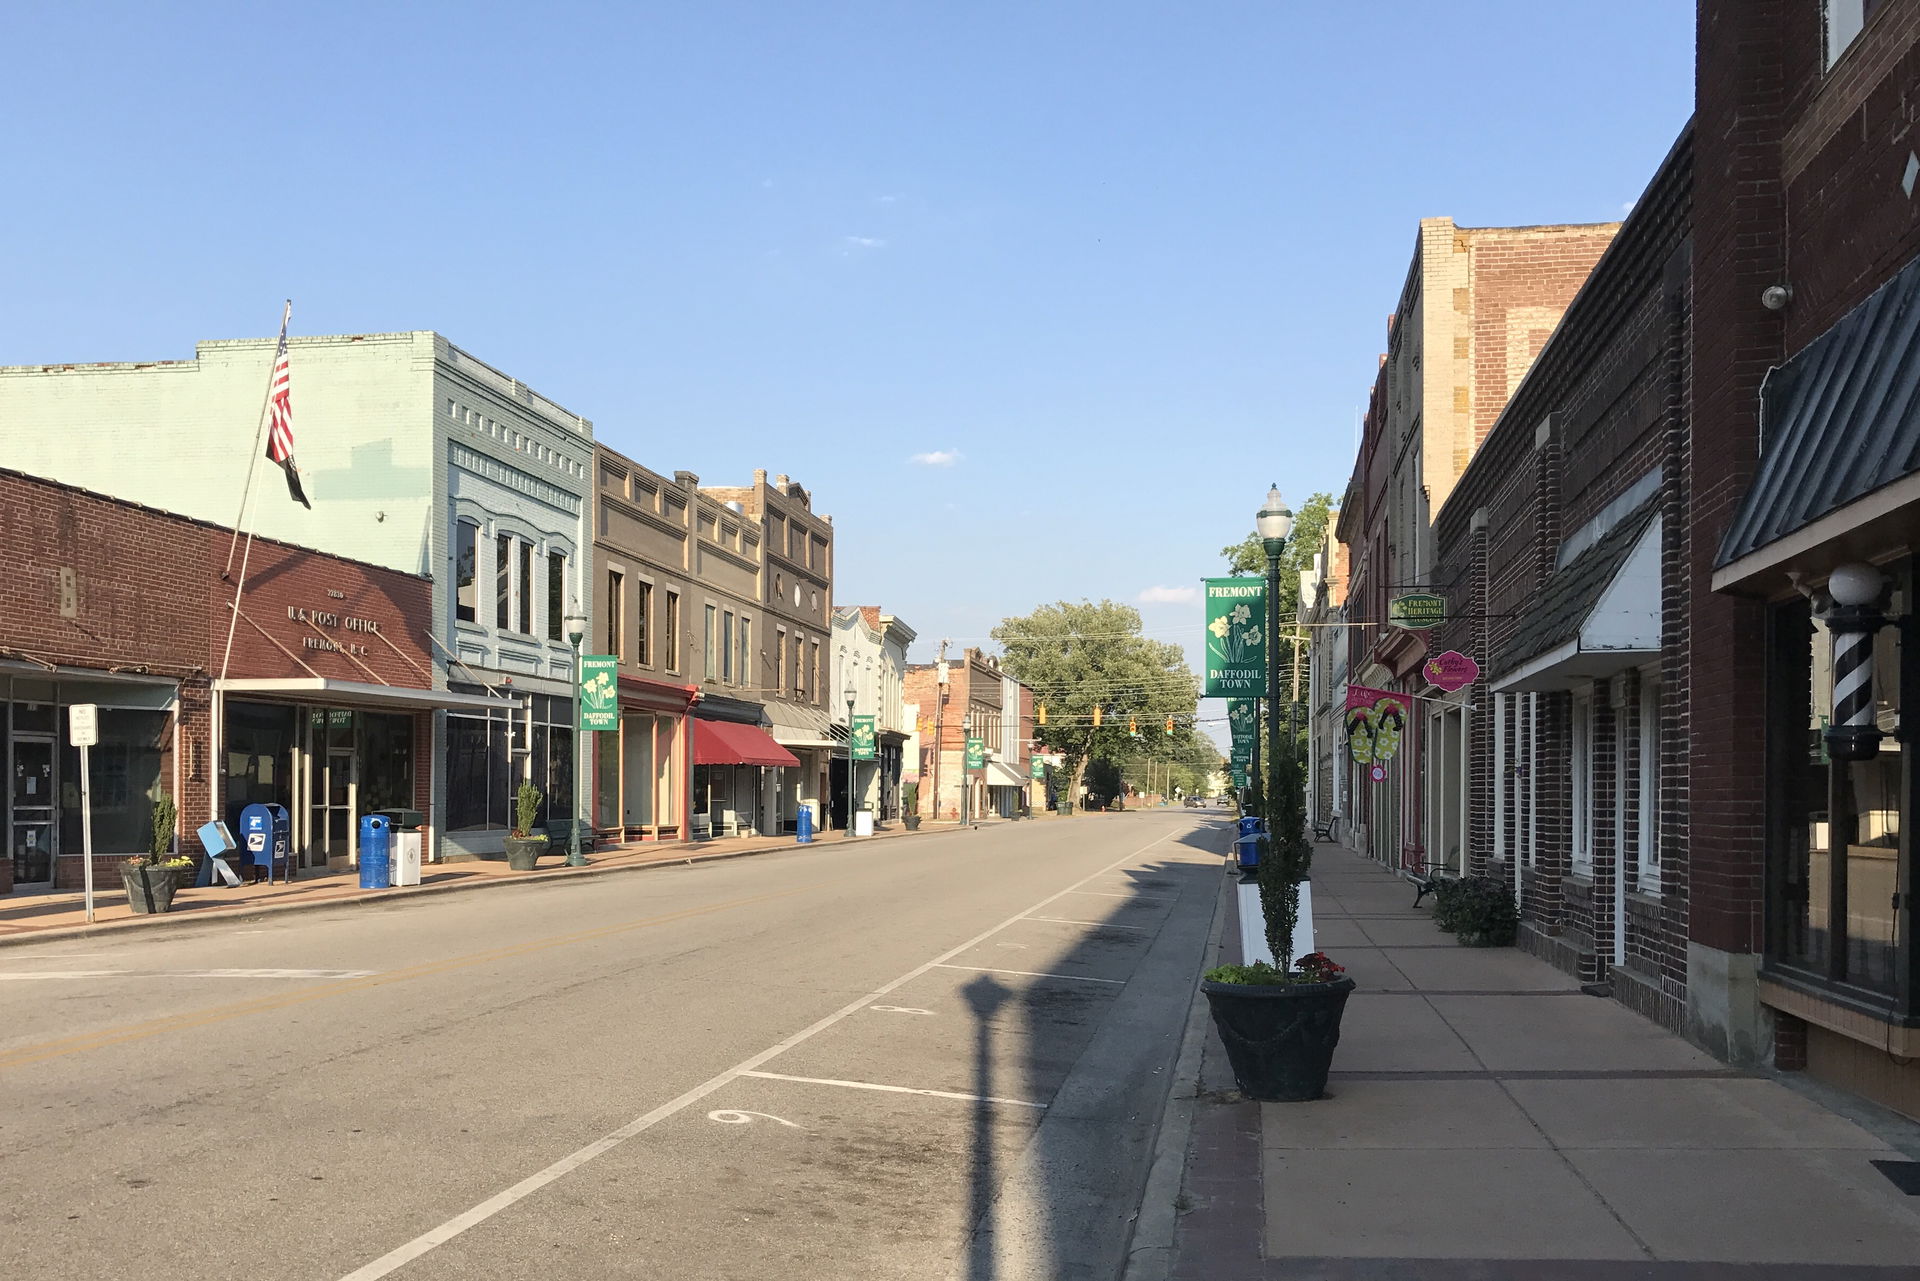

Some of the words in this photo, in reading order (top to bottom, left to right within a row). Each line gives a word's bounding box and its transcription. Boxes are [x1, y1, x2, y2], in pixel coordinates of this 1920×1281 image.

[1208, 586, 1263, 598] FREMONT
[1408, 607, 1443, 615] HERITAGE
[311, 609, 338, 627] POST
[345, 616, 379, 633] OFFICE
[1210, 669, 1262, 679] DAFFODIL
[1219, 679, 1251, 689] TOWN
